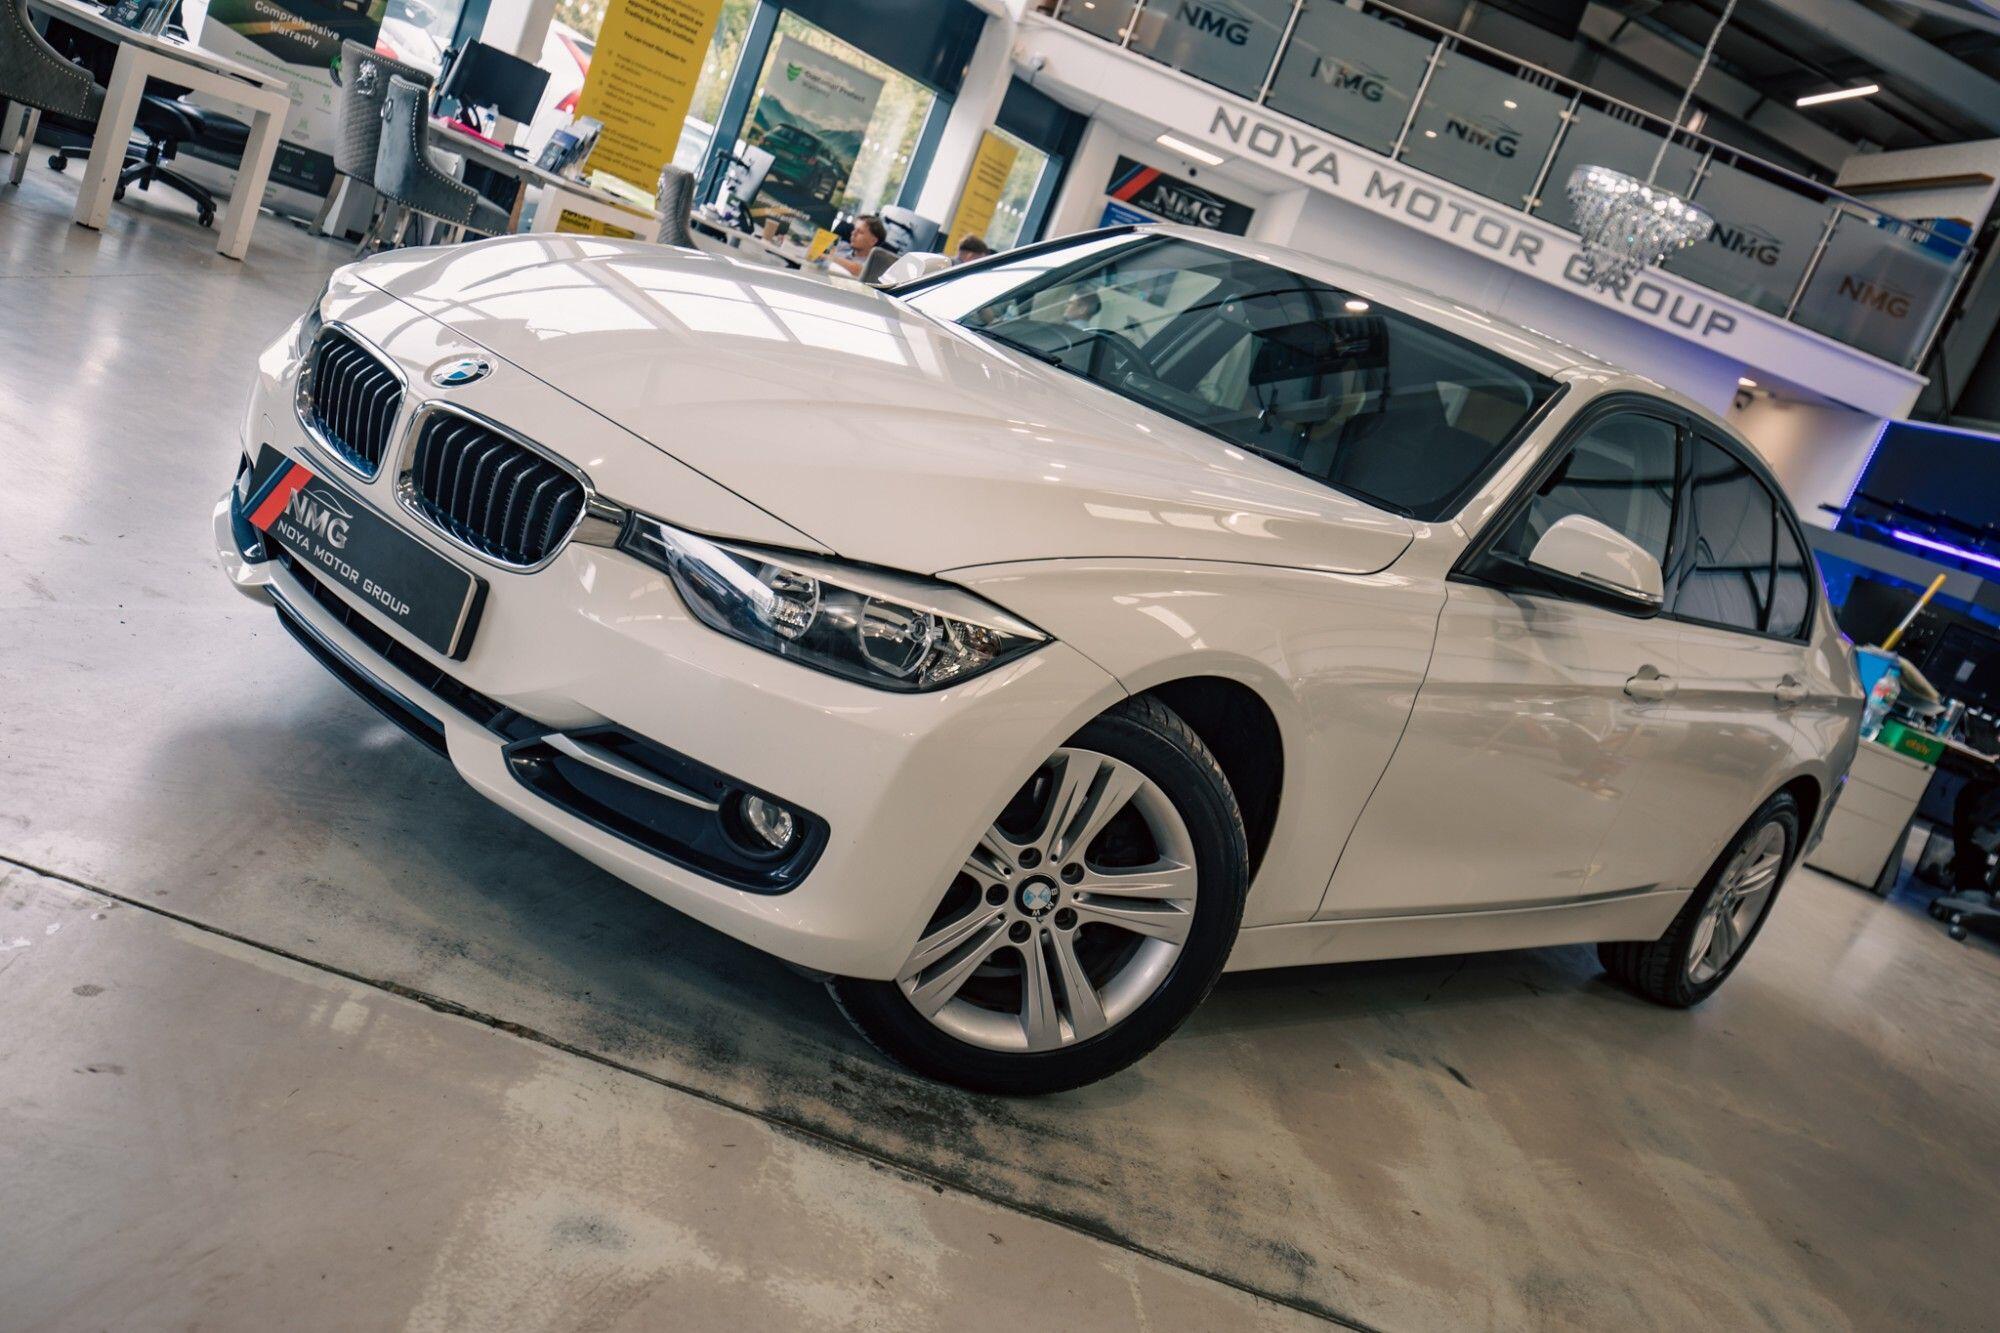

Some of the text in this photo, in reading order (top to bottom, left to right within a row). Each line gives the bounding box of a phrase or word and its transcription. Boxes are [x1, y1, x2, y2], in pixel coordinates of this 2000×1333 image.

[255, 1, 340, 40] Comprehensive
[270, 21, 319, 48] Warranty
[1175, 1, 1250, 46] NMG
[1311, 56, 1385, 102] NMG
[1445, 118, 1519, 158] NMG
[1153, 185, 1224, 228] NMG
[1209, 106, 1737, 336] NOYA MOTOR GROUP
[1707, 222, 1780, 266] NMG
[1838, 275, 1913, 318] NMG
[284, 487, 350, 549] NMG
[277, 520, 411, 616] NOYA MOTOR GROUP
[1032, 888, 1058, 916] BMW
